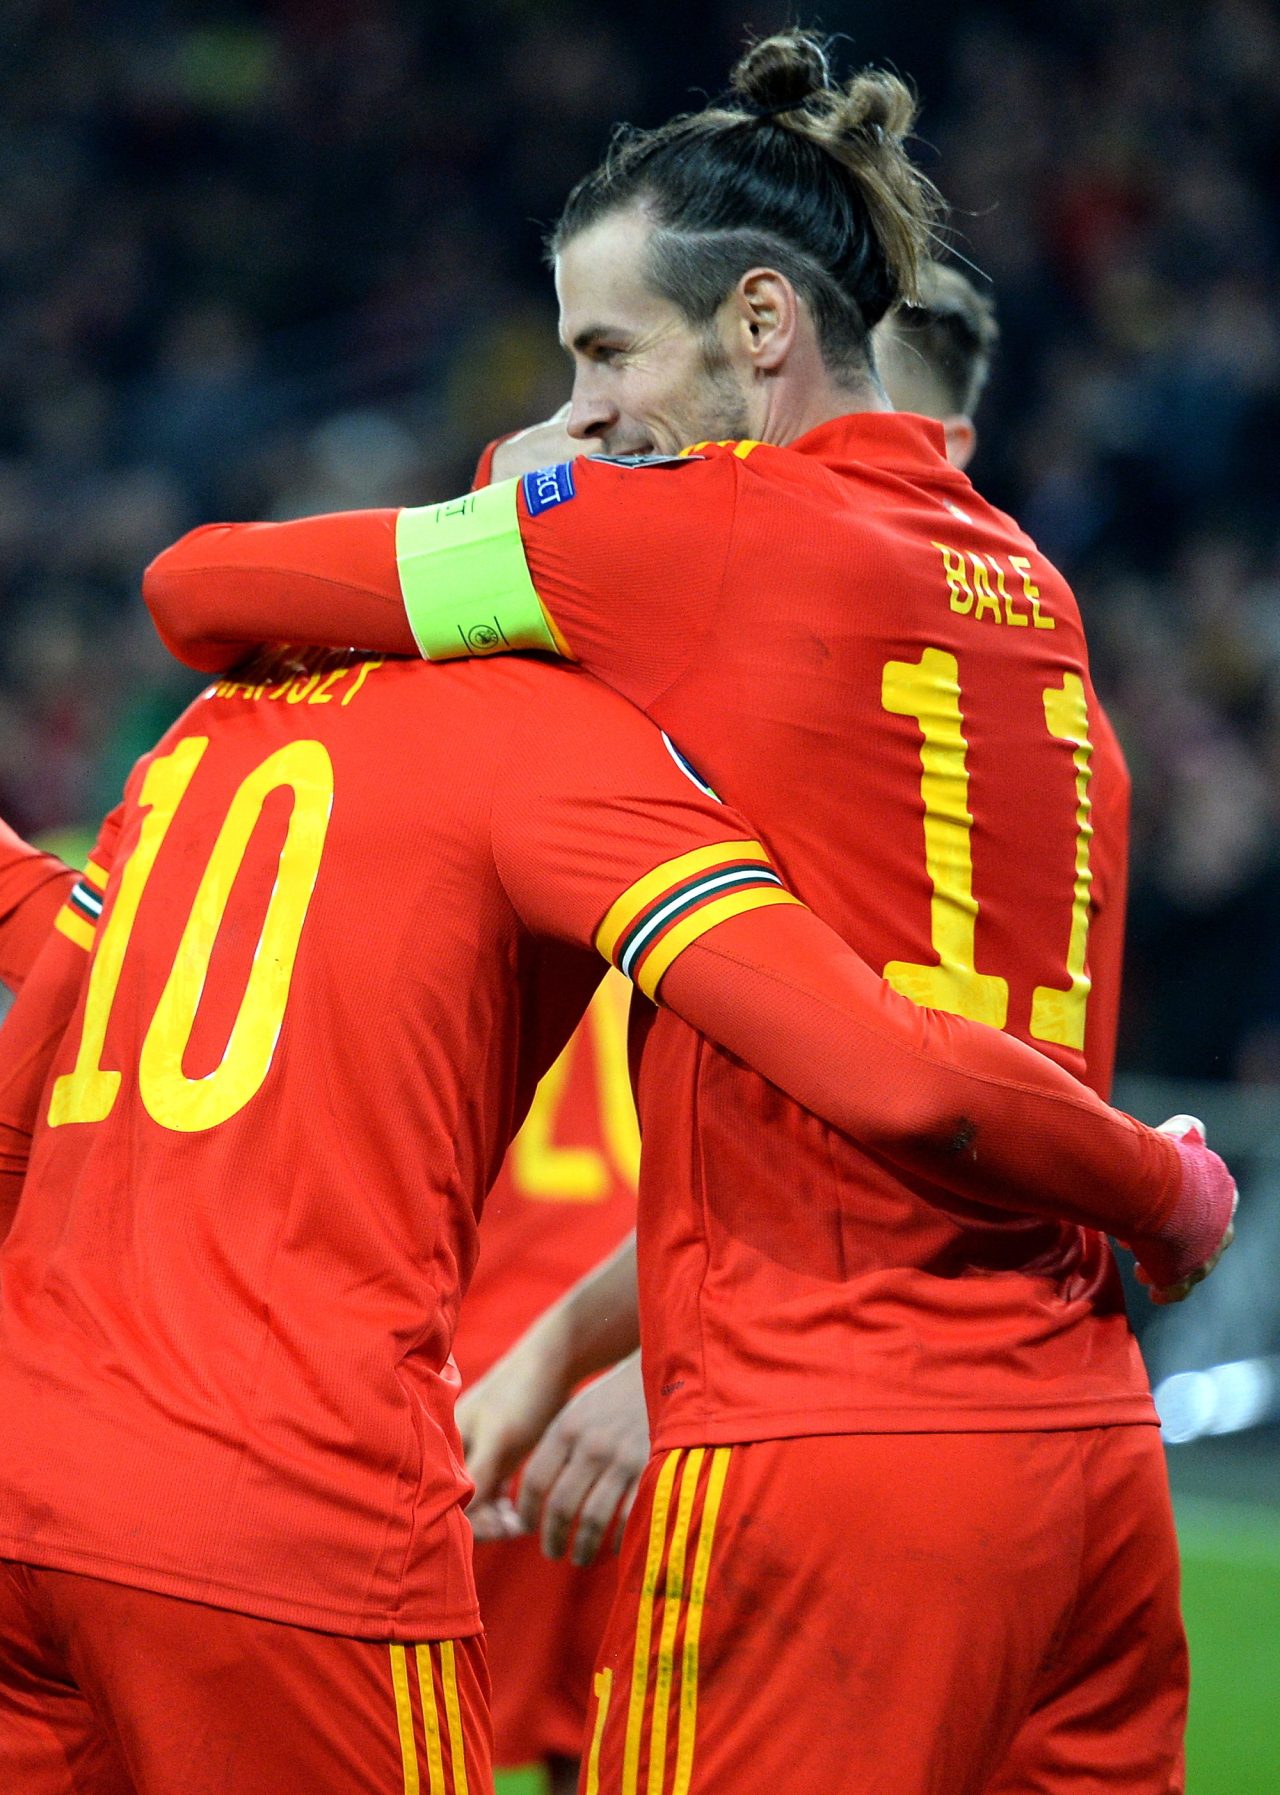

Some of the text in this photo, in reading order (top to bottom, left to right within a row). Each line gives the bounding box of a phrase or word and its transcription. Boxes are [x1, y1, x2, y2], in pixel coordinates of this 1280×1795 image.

[931, 541, 1055, 629] BALE
[48, 736, 335, 1133] 10
[882, 647, 1094, 1051] 11
